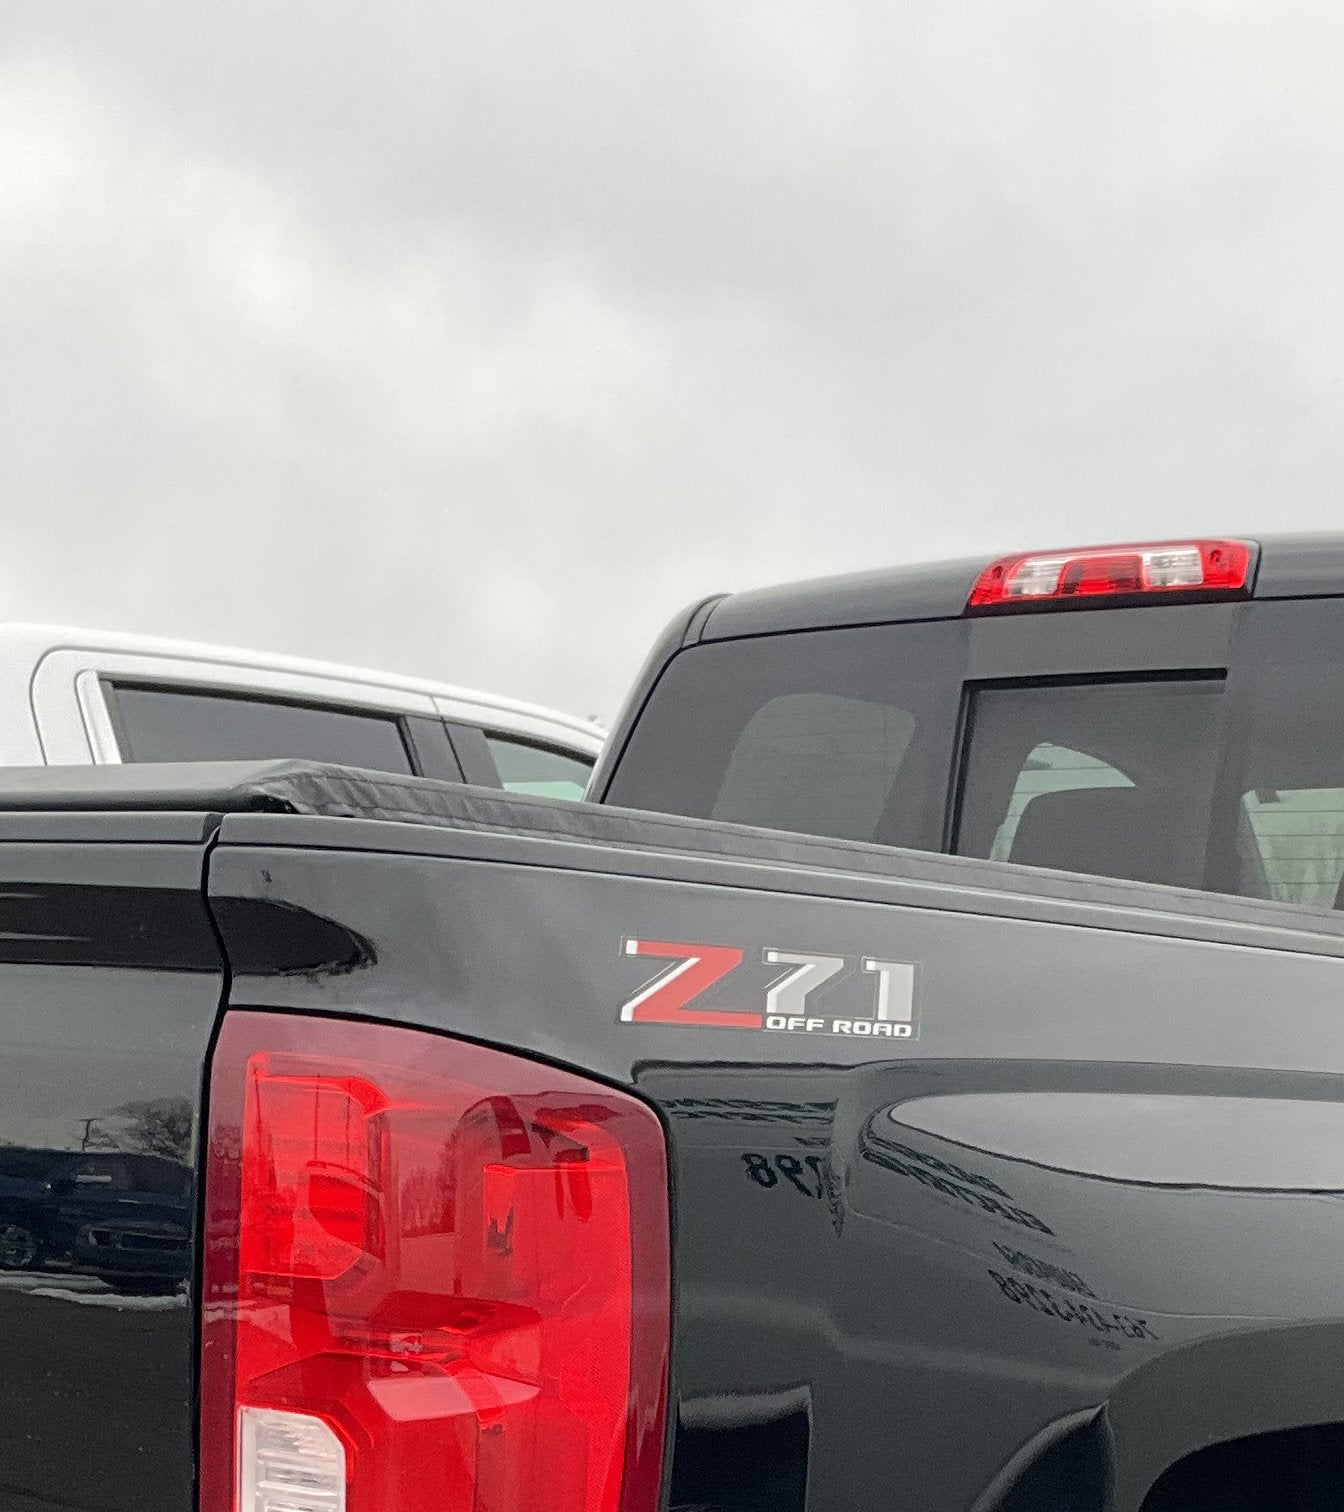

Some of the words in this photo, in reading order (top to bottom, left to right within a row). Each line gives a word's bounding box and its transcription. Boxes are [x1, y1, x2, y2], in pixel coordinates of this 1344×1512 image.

[619, 938, 915, 1029] Z71
[766, 1014, 825, 1034] OFF
[831, 1016, 912, 1038] ROAD
